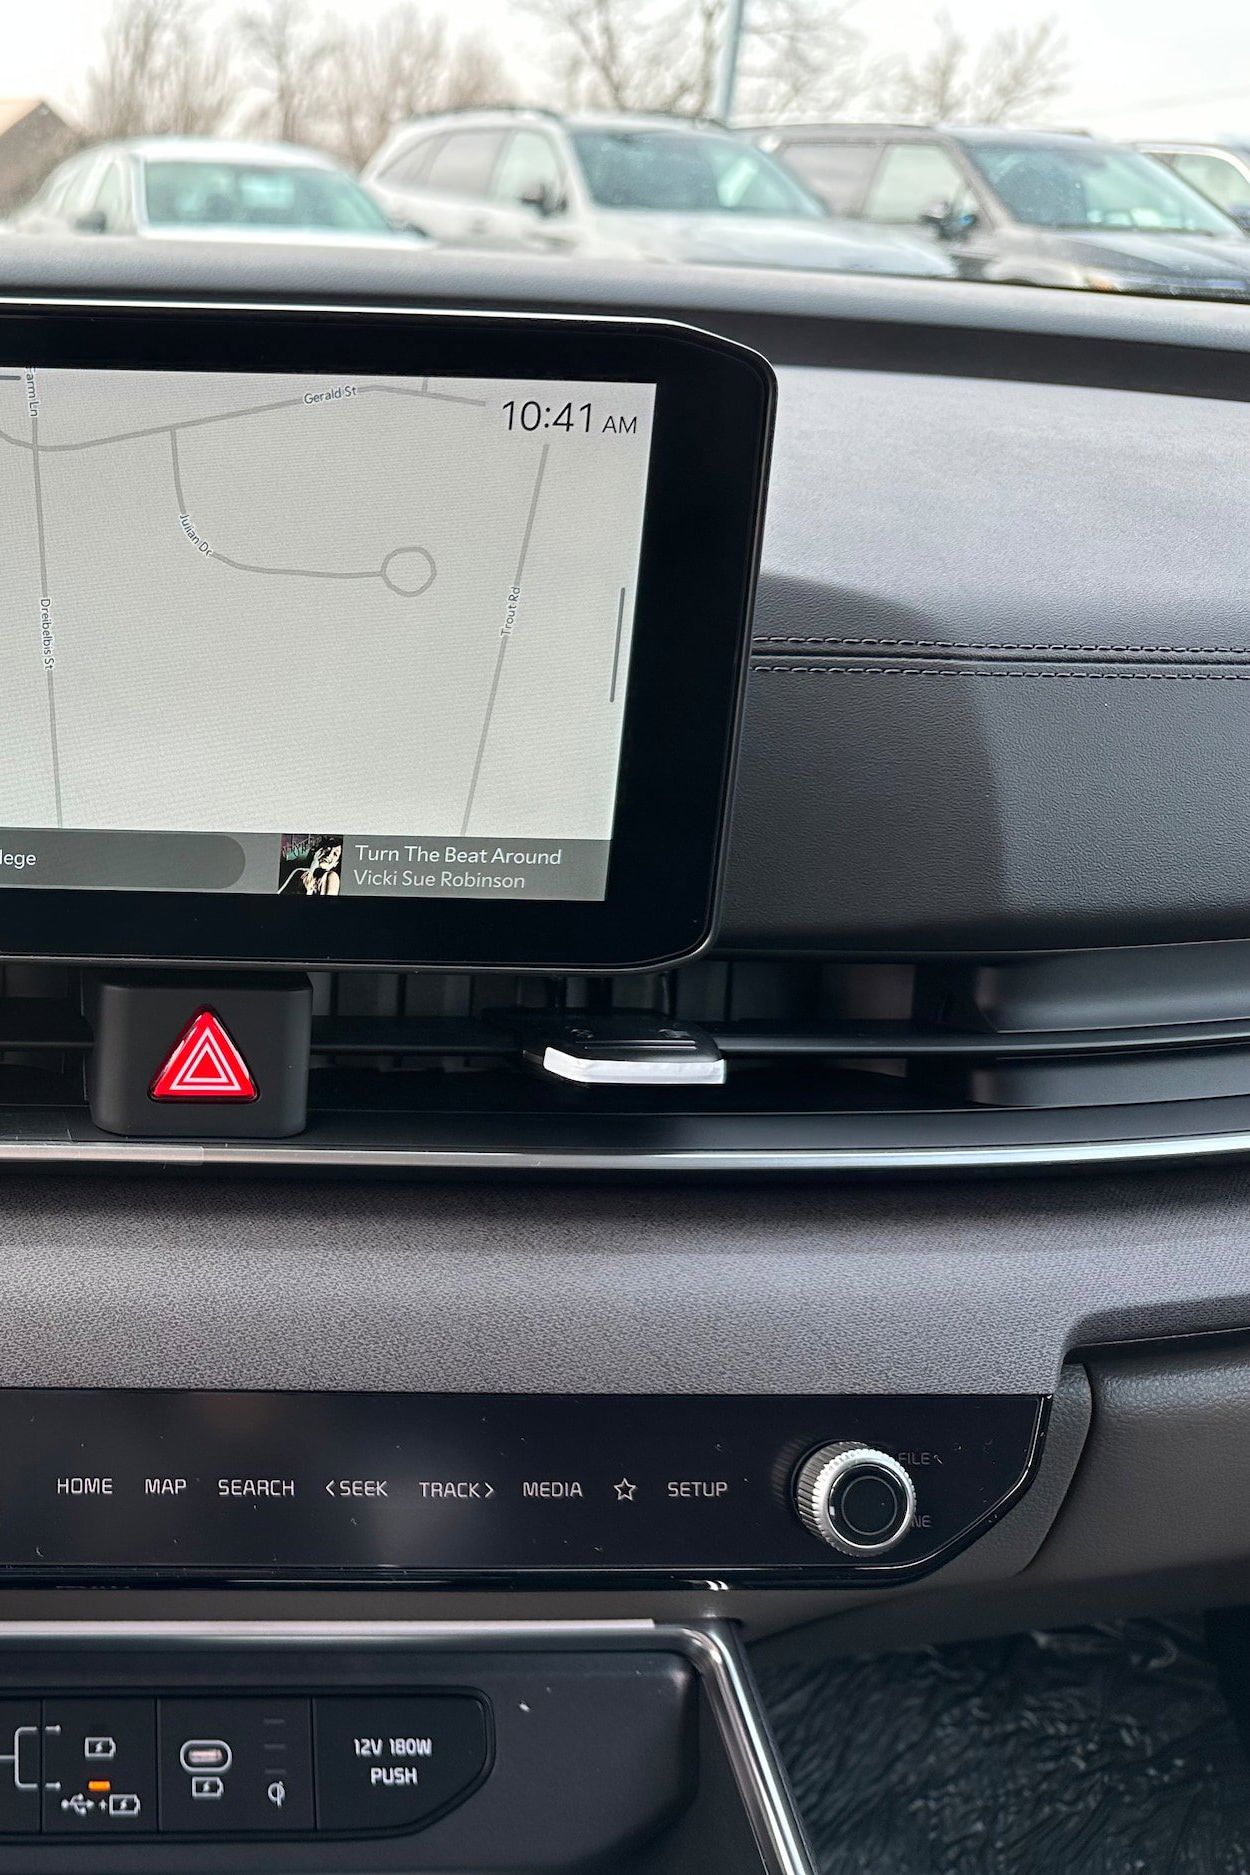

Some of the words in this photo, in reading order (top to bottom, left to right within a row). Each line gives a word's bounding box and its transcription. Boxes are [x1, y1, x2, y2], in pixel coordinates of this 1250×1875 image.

[303, 386, 343, 405] Gerald
[344, 385, 357, 398] St
[29, 401, 40, 417] Ln
[502, 400, 592, 433] 10:41
[601, 415, 638, 434] AM
[179, 514, 200, 545] Julian
[198, 541, 213, 557] Dr
[507, 586, 521, 602] Rd
[40, 598, 54, 655] Dreibelbis
[500, 604, 517, 637] Trout
[44, 657, 55, 670] St
[354, 844, 399, 862] Turn
[403, 845, 440, 862] The
[444, 847, 488, 864] Beat
[490, 847, 563, 865] Around
[353, 869, 398, 886] Vicki
[401, 870, 436, 887] Sue
[440, 871, 526, 889] Robinson
[898, 1452, 931, 1466] FILE
[57, 1477, 113, 1495] HOME
[144, 1478, 187, 1495] MAP
[218, 1479, 295, 1497] SEARCH
[522, 1481, 584, 1498] MEDIA
[667, 1481, 729, 1498] SETUP
[353, 1737, 384, 1757] 12V
[389, 1737, 433, 1757] 180W
[370, 1766, 419, 1786] PUSH
